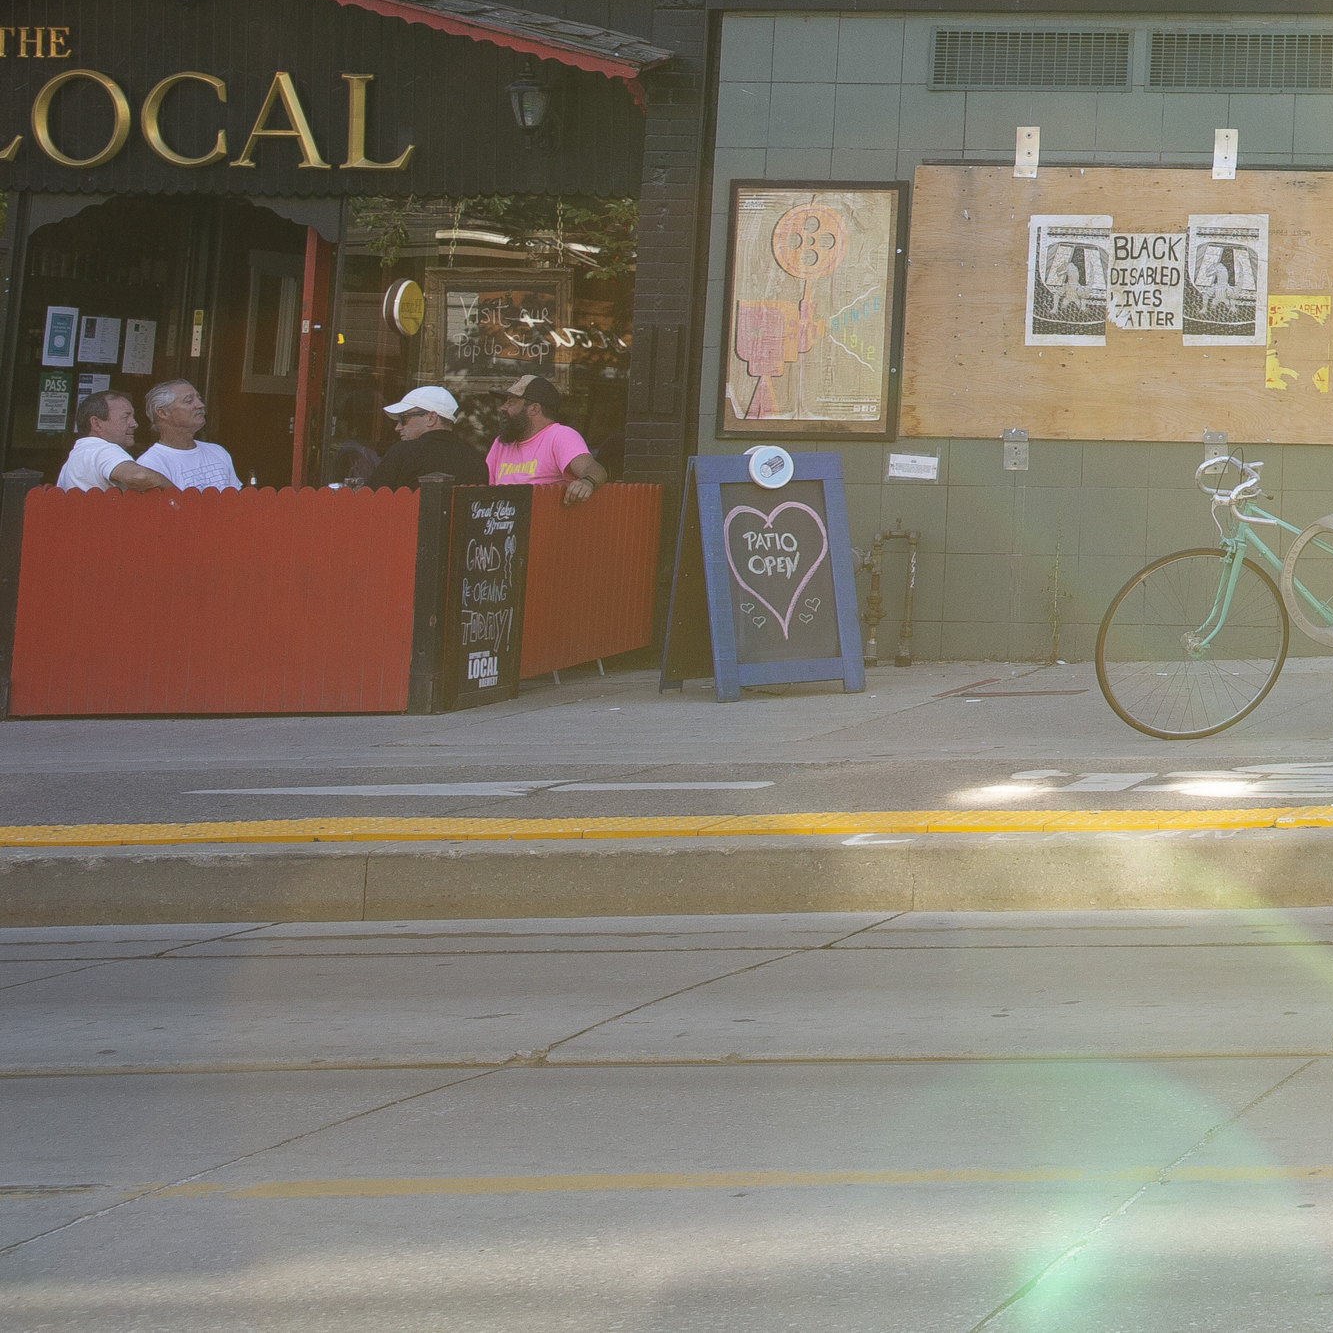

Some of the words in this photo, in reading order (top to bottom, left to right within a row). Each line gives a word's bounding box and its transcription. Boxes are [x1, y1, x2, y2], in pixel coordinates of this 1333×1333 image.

[0, 69, 415, 169] OCAL
[1113, 236, 1183, 262] BLACK
[1110, 266, 1180, 286] DISABLED
[1111, 290, 1162, 308] LIVES
[831, 296, 882, 333] SINCE
[1115, 310, 1175, 327] ATTER
[452, 332, 481, 363] Pop
[843, 329, 876, 360] 1912
[45, 379, 67, 391] PASS
[471, 501, 494, 520] Great
[494, 500, 516, 520] Lakes
[484, 517, 514, 535] Brewery
[742, 531, 797, 552] PATIO
[466, 539, 501, 571] GRAND
[748, 552, 800, 579] OPEN
[461, 607, 514, 652] TODAY!
[468, 656, 499, 680] LOCAL
